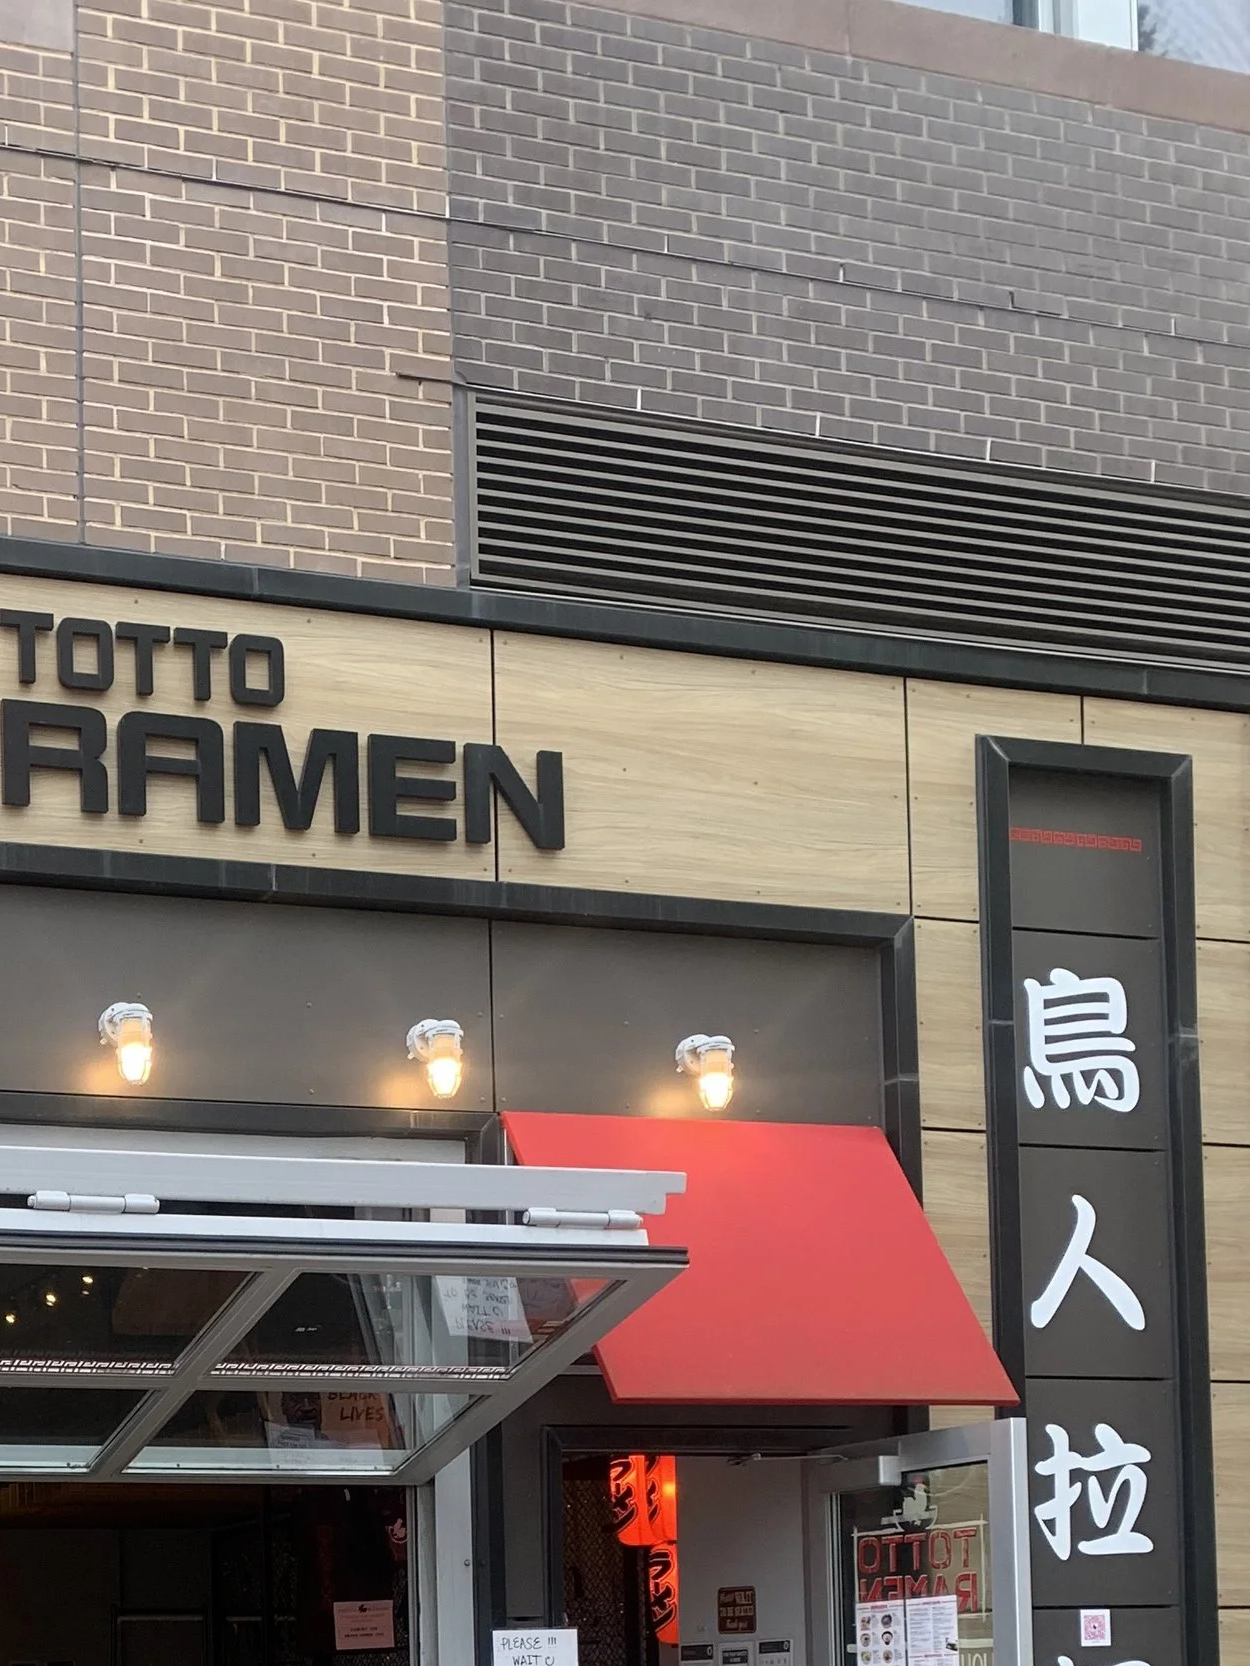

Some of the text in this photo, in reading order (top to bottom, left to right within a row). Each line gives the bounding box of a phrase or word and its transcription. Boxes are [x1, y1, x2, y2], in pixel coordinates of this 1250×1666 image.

[340, 1407, 384, 1422] LIVES
[502, 1637, 542, 1650] PLEASE
[512, 1654, 542, 1666] WAIT
